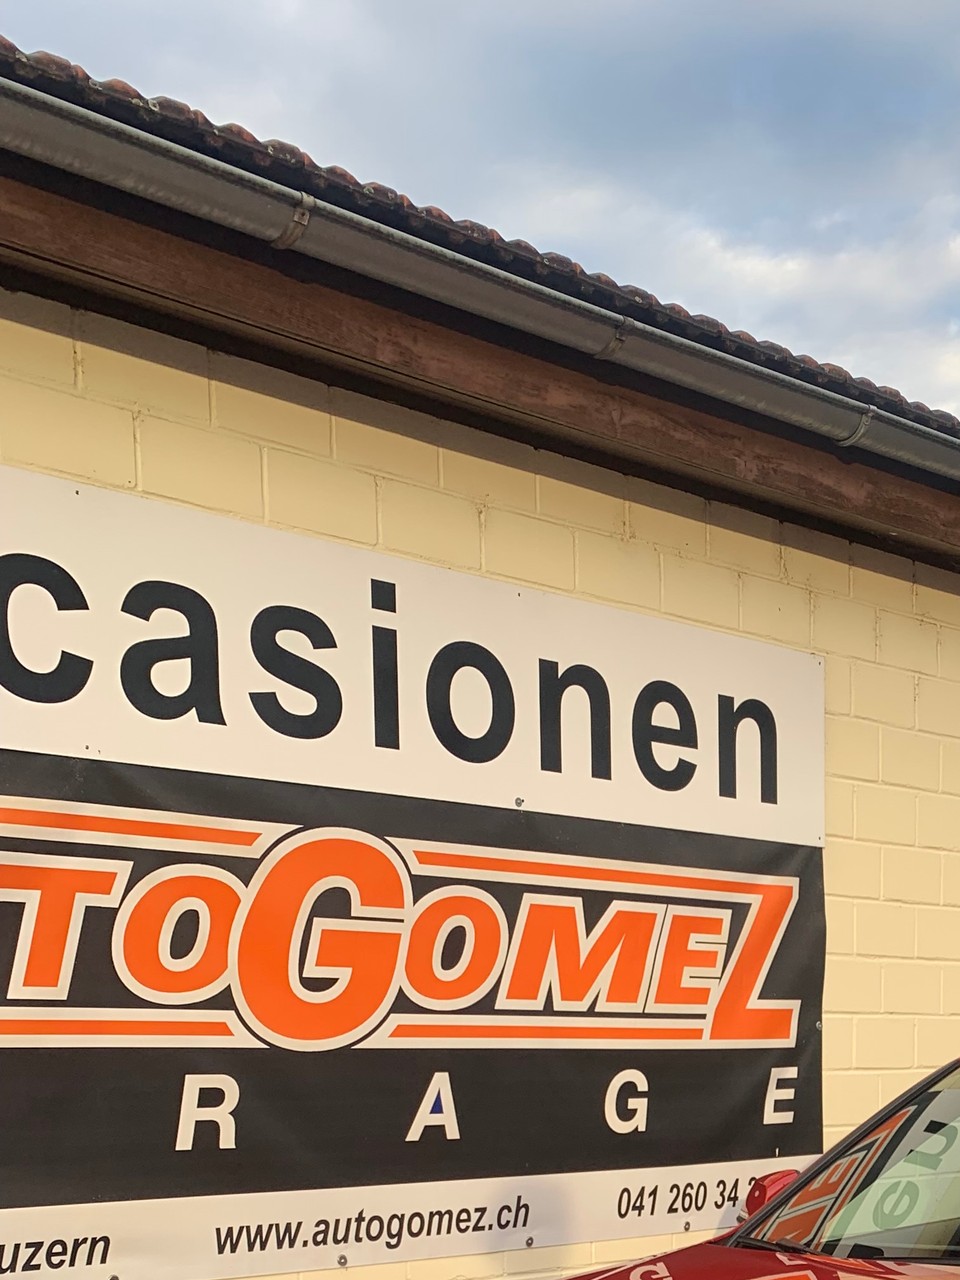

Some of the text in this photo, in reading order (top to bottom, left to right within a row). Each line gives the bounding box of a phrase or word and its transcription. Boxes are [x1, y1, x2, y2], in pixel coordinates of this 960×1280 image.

[0, 552, 778, 806] casionen
[215, 1195, 530, 1255] www.autogomez.ch
[617, 1184, 659, 1219] 041
[667, 1181, 708, 1214] 260
[714, 1178, 739, 1210] 34
